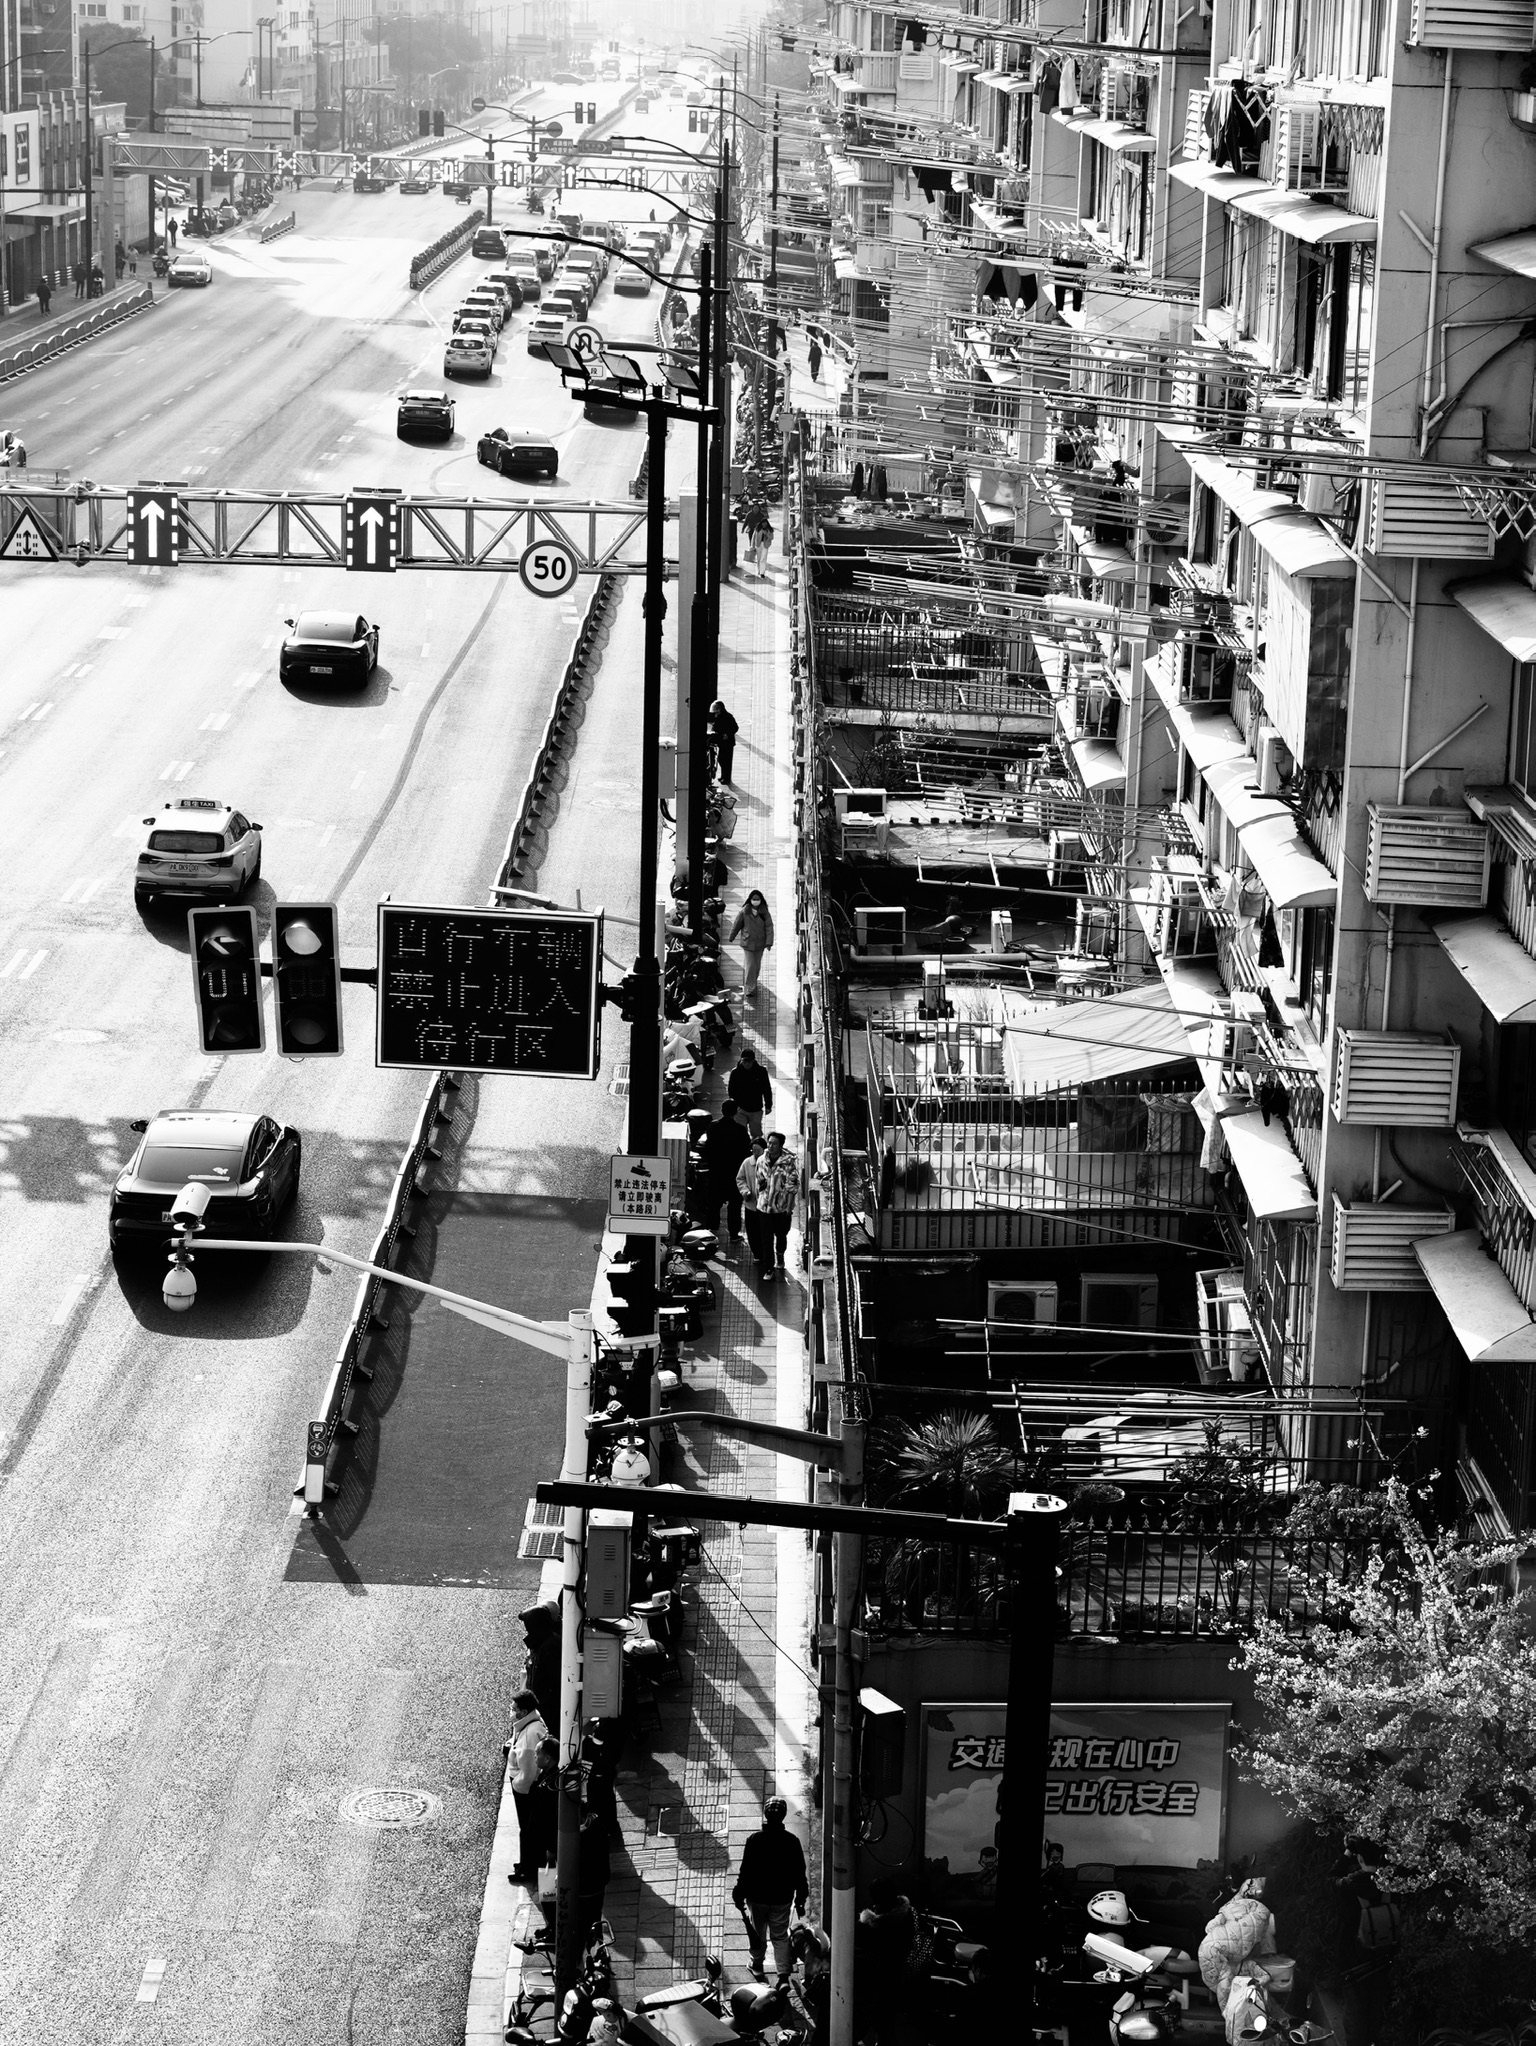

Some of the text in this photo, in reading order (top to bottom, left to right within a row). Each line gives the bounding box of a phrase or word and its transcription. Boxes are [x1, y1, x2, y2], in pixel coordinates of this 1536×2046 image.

[534, 555, 567, 581] 50
[388, 969, 581, 1016] 禁止进入
[415, 1016, 554, 1064] 待行区
[614, 1178, 667, 1192] 禁止违法停车
[618, 1190, 662, 1203] 请立即驶离
[950, 1735, 1181, 1771] 交通规在心中
[999, 1780, 1199, 1815] 记出行安全
